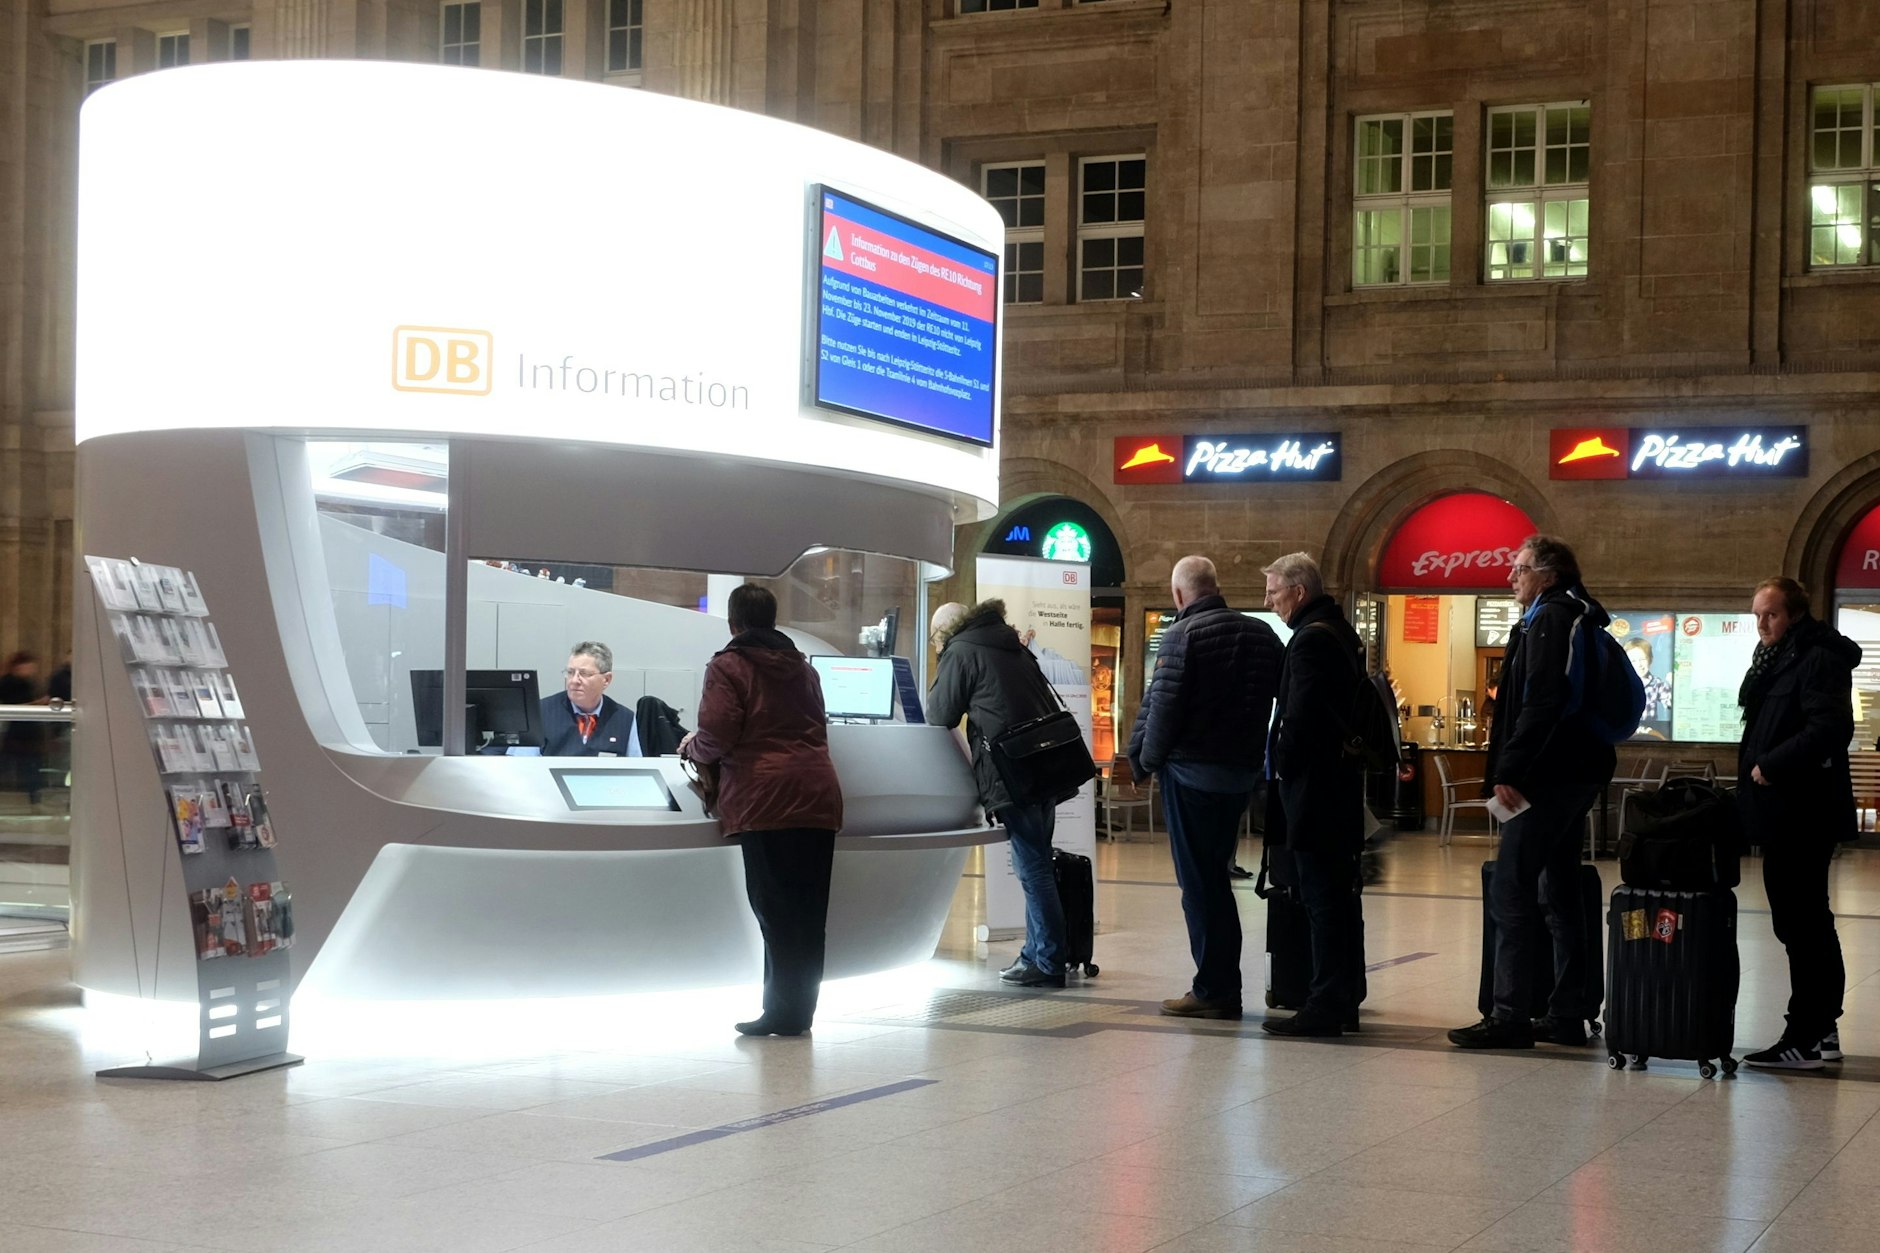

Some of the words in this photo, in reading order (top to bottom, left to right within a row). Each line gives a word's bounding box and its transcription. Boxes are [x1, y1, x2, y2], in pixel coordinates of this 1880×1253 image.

[851, 252, 876, 271] Cottbus
[851, 233, 890, 258] Information
[930, 264, 940, 277] des
[941, 267, 956, 283] RE10
[958, 273, 982, 295] Richtung
[823, 275, 850, 292] Aufgrund
[851, 286, 862, 295] von
[823, 289, 852, 307] November
[853, 299, 862, 310] bis
[864, 302, 872, 314] 23.
[874, 306, 901, 322] November
[821, 334, 836, 347] Bitte
[404, 336, 480, 384] DB
[519, 353, 749, 410] Information
[1185, 441, 1268, 476] Pizza
[1270, 440, 1334, 472] Hut
[1631, 434, 1725, 472] Pizza
[1728, 433, 1801, 467] Hut
[1064, 573, 1076, 582] DB
[1412, 546, 1518, 578] Express
[1066, 621, 1084, 630] fertig.
